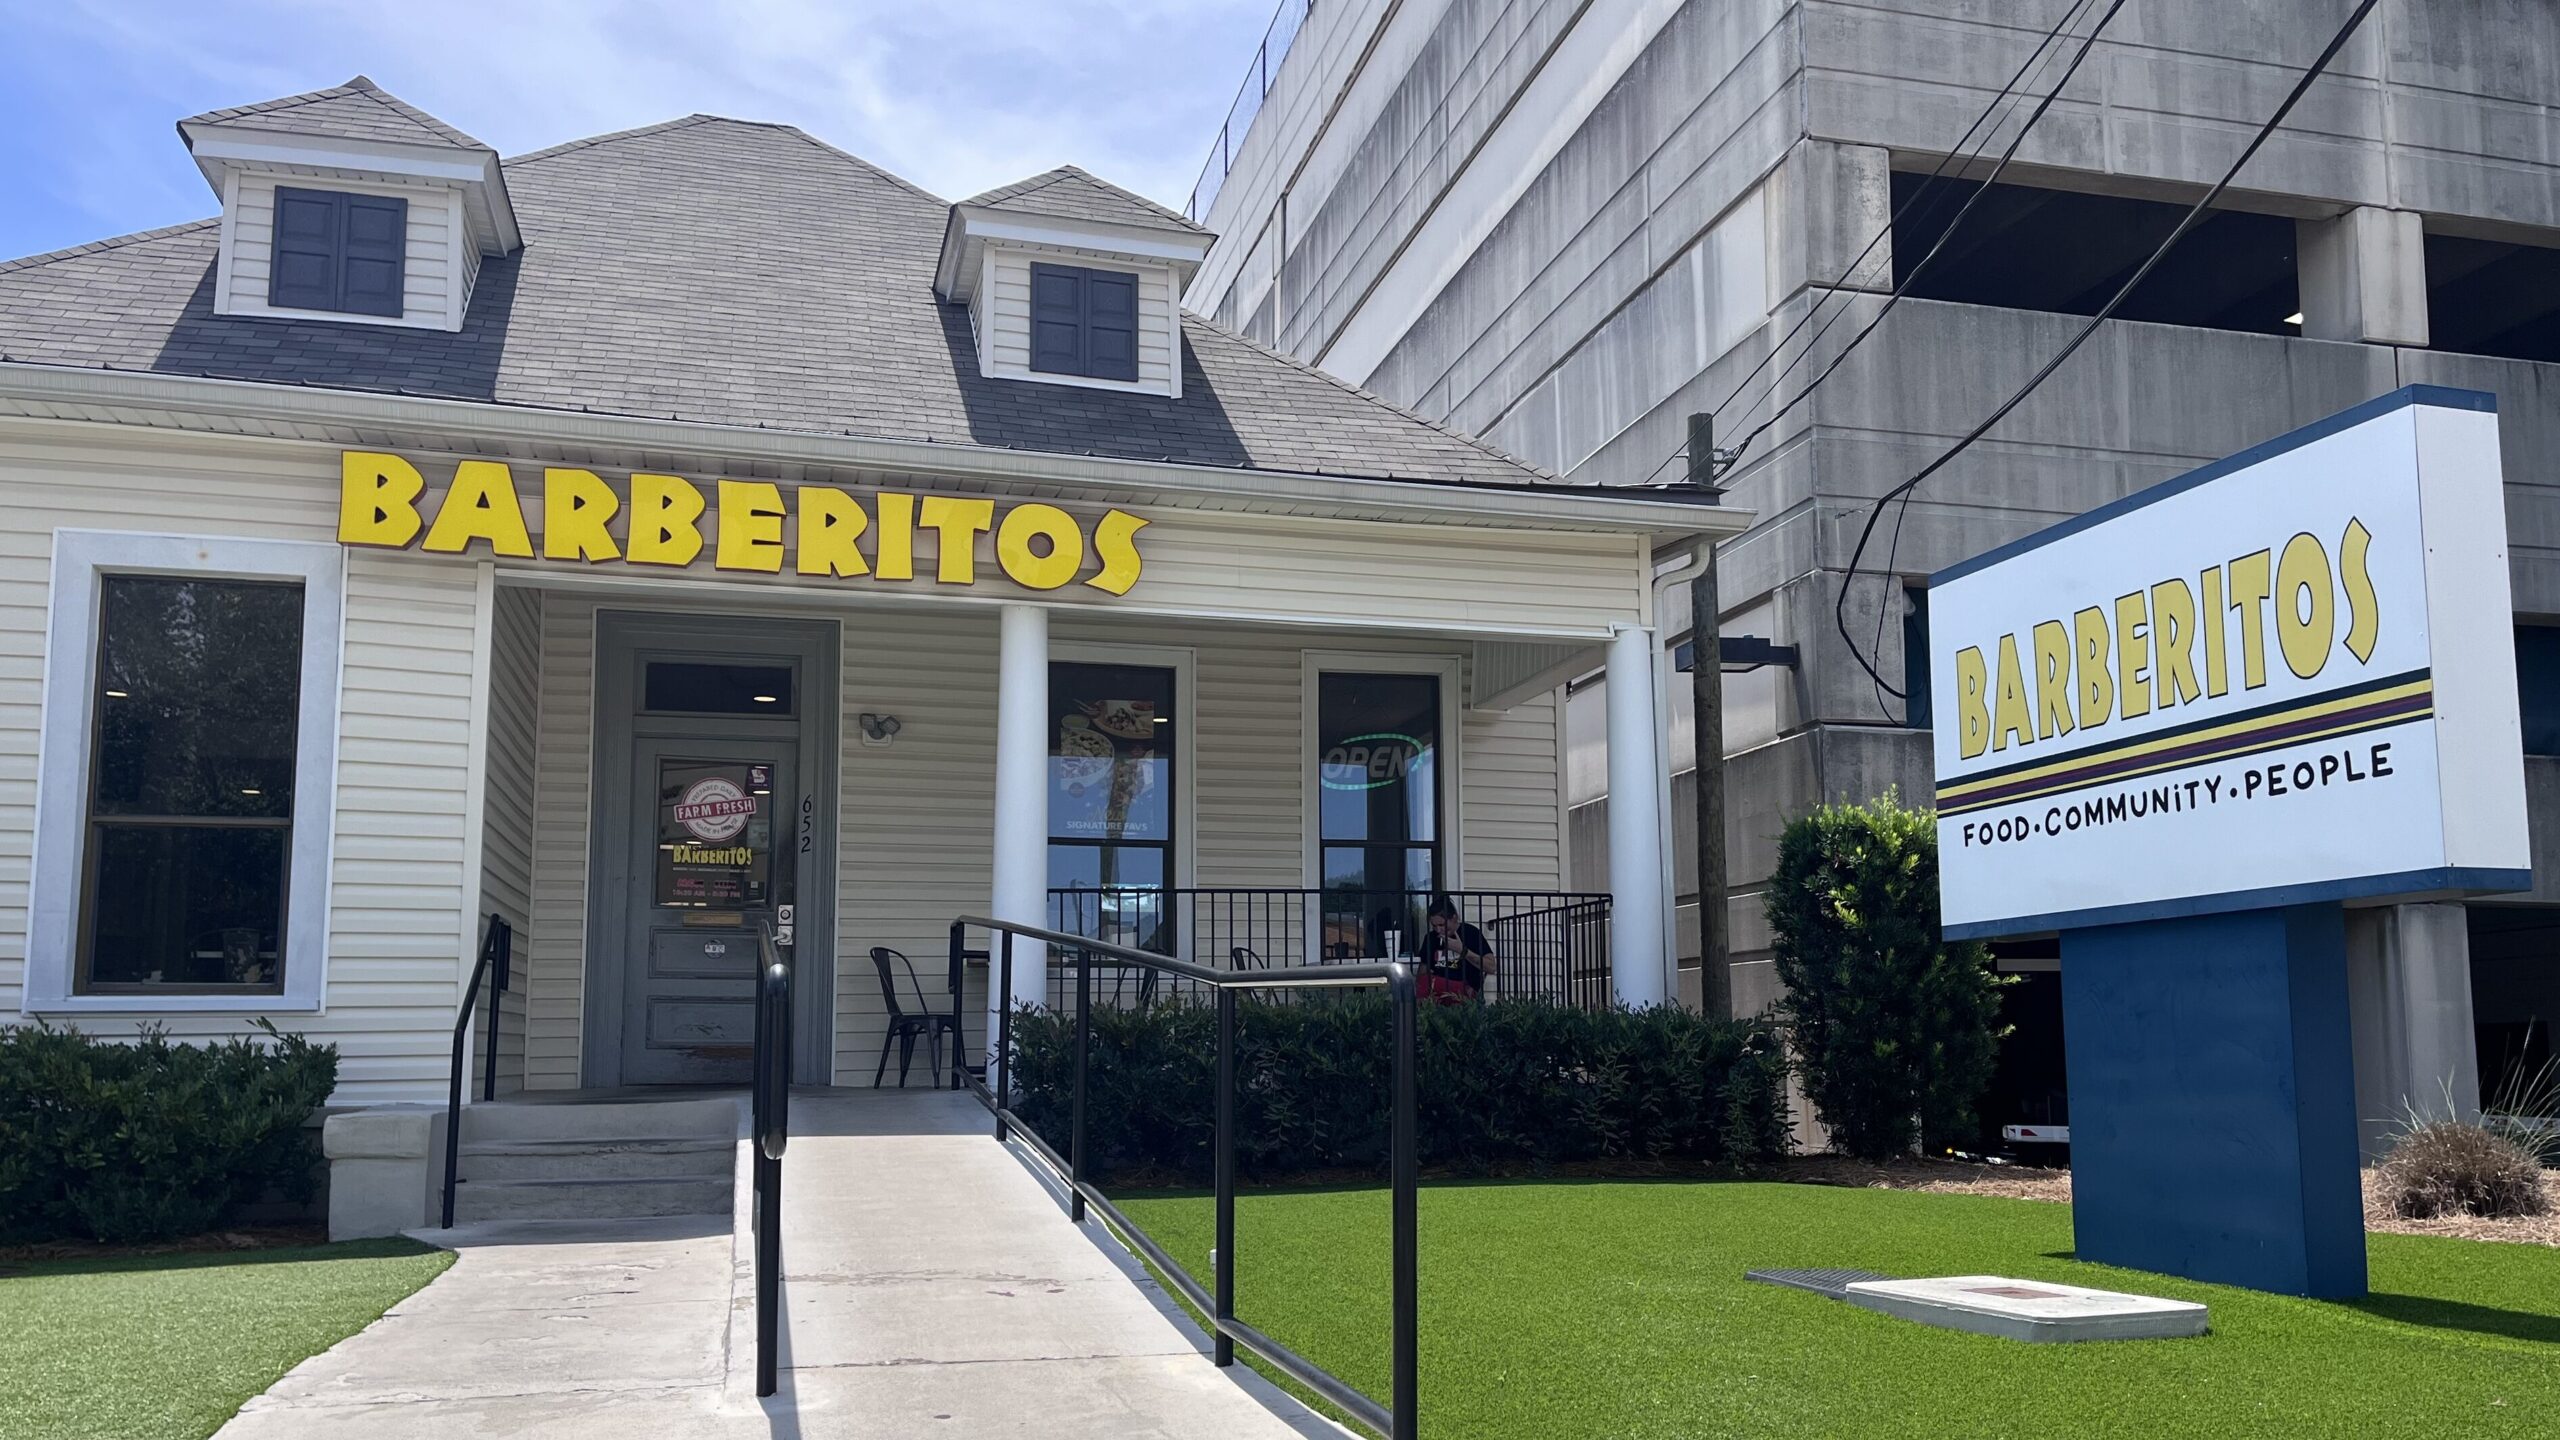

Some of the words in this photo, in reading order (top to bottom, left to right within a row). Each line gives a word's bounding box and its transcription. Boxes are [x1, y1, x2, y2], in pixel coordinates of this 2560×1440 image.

[336, 449, 1152, 598] BARBERITOS
[1955, 515, 2379, 760] BARBERITOS
[1322, 745, 1413, 779] OPEN
[677, 804, 712, 820] FARM
[715, 799, 753, 815] FRESH
[1065, 820, 1123, 832] SIGNATURE
[1123, 821, 1149, 832] FAVS
[672, 844, 753, 866] BARBERITOS
